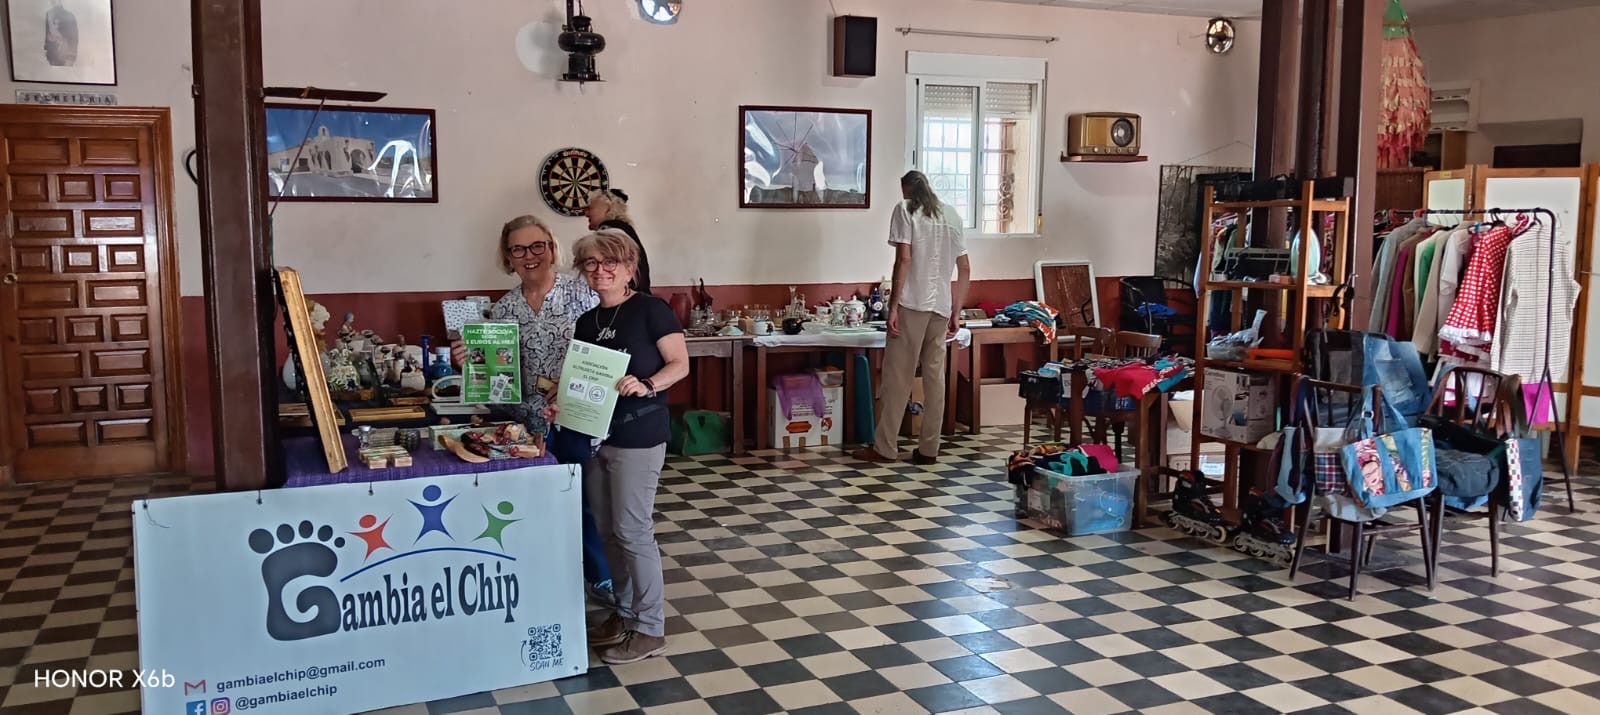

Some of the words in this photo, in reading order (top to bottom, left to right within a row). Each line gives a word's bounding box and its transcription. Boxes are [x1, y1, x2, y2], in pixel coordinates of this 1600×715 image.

[23, 92, 112, 105] SECRETARIA
[262, 541, 428, 641] Gambia
[431, 567, 455, 620] el
[458, 561, 520, 623] Chip
[216, 657, 386, 692] gambiaelchip@gmail.com
[234, 683, 338, 711] @gambiaelchip
